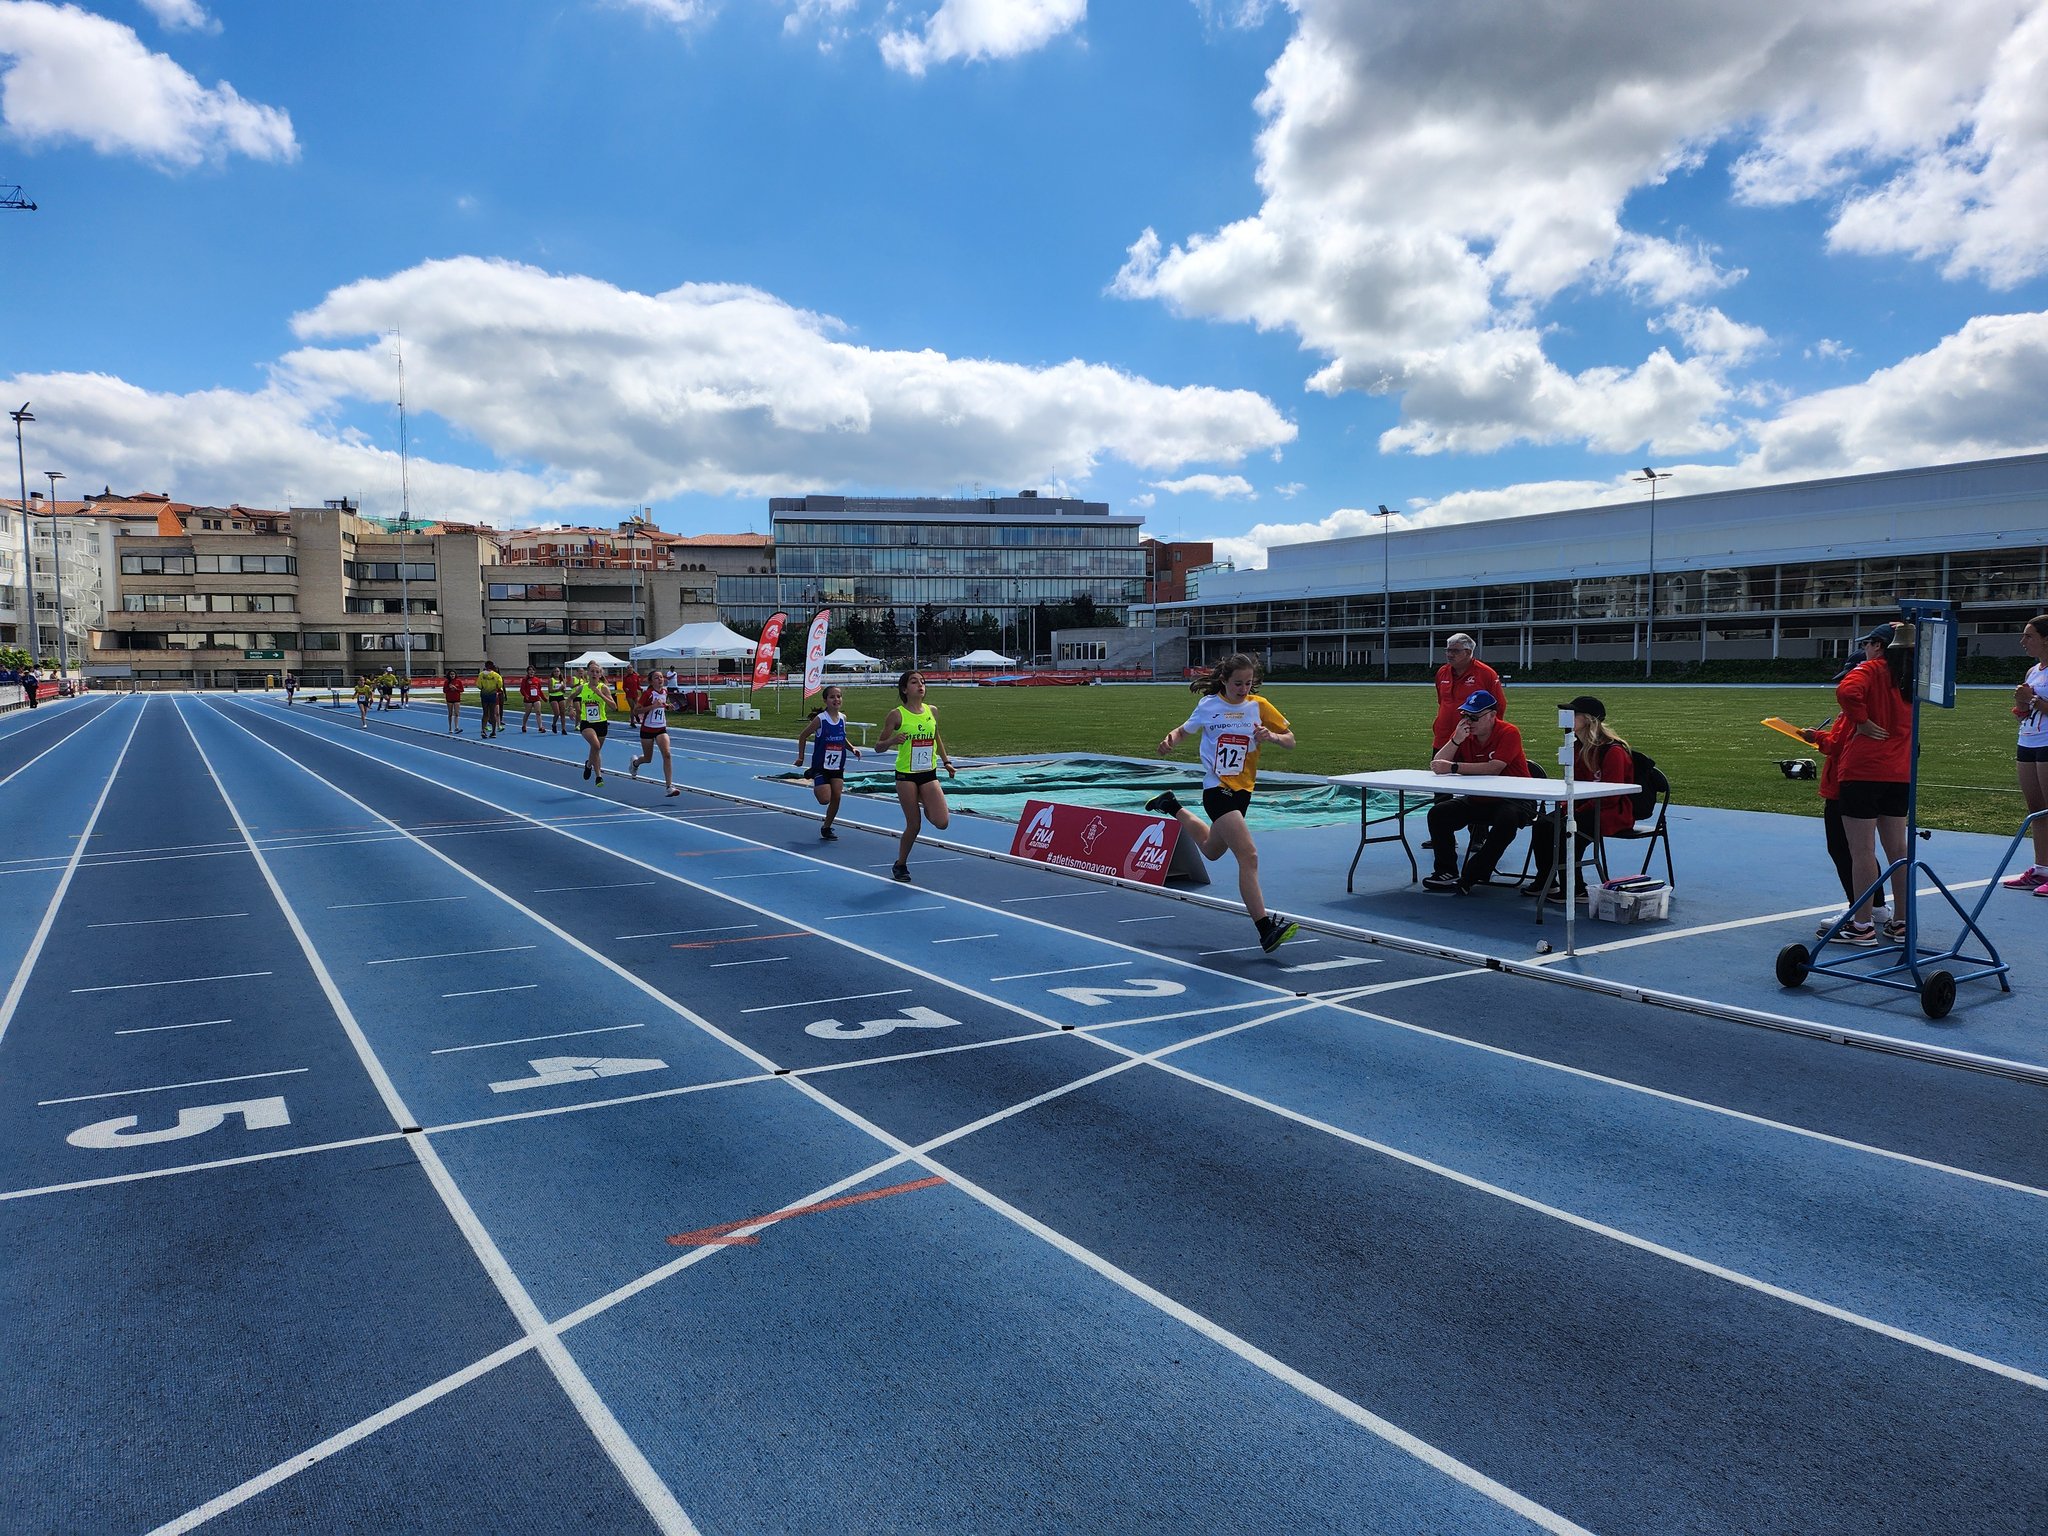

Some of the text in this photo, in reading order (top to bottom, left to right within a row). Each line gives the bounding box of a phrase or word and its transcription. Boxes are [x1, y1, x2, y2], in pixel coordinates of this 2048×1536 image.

[588, 708, 598, 717] 20
[654, 709, 663, 719] 14
[826, 753, 839, 766] 17
[917, 751, 929, 765] 13
[1218, 747, 1239, 769] 12
[1029, 841, 1050, 849] ATLETISMO
[1031, 828, 1055, 844] FNA
[1046, 851, 1118, 876] #atletismonavarro
[1138, 846, 1168, 865] FNA
[1135, 861, 1162, 871] ATLETISMO
[1278, 955, 1385, 973] 1
[1046, 978, 1187, 1007] 2
[804, 1005, 963, 1040] 3
[488, 1056, 670, 1093] 4
[66, 1096, 291, 1149] 5
